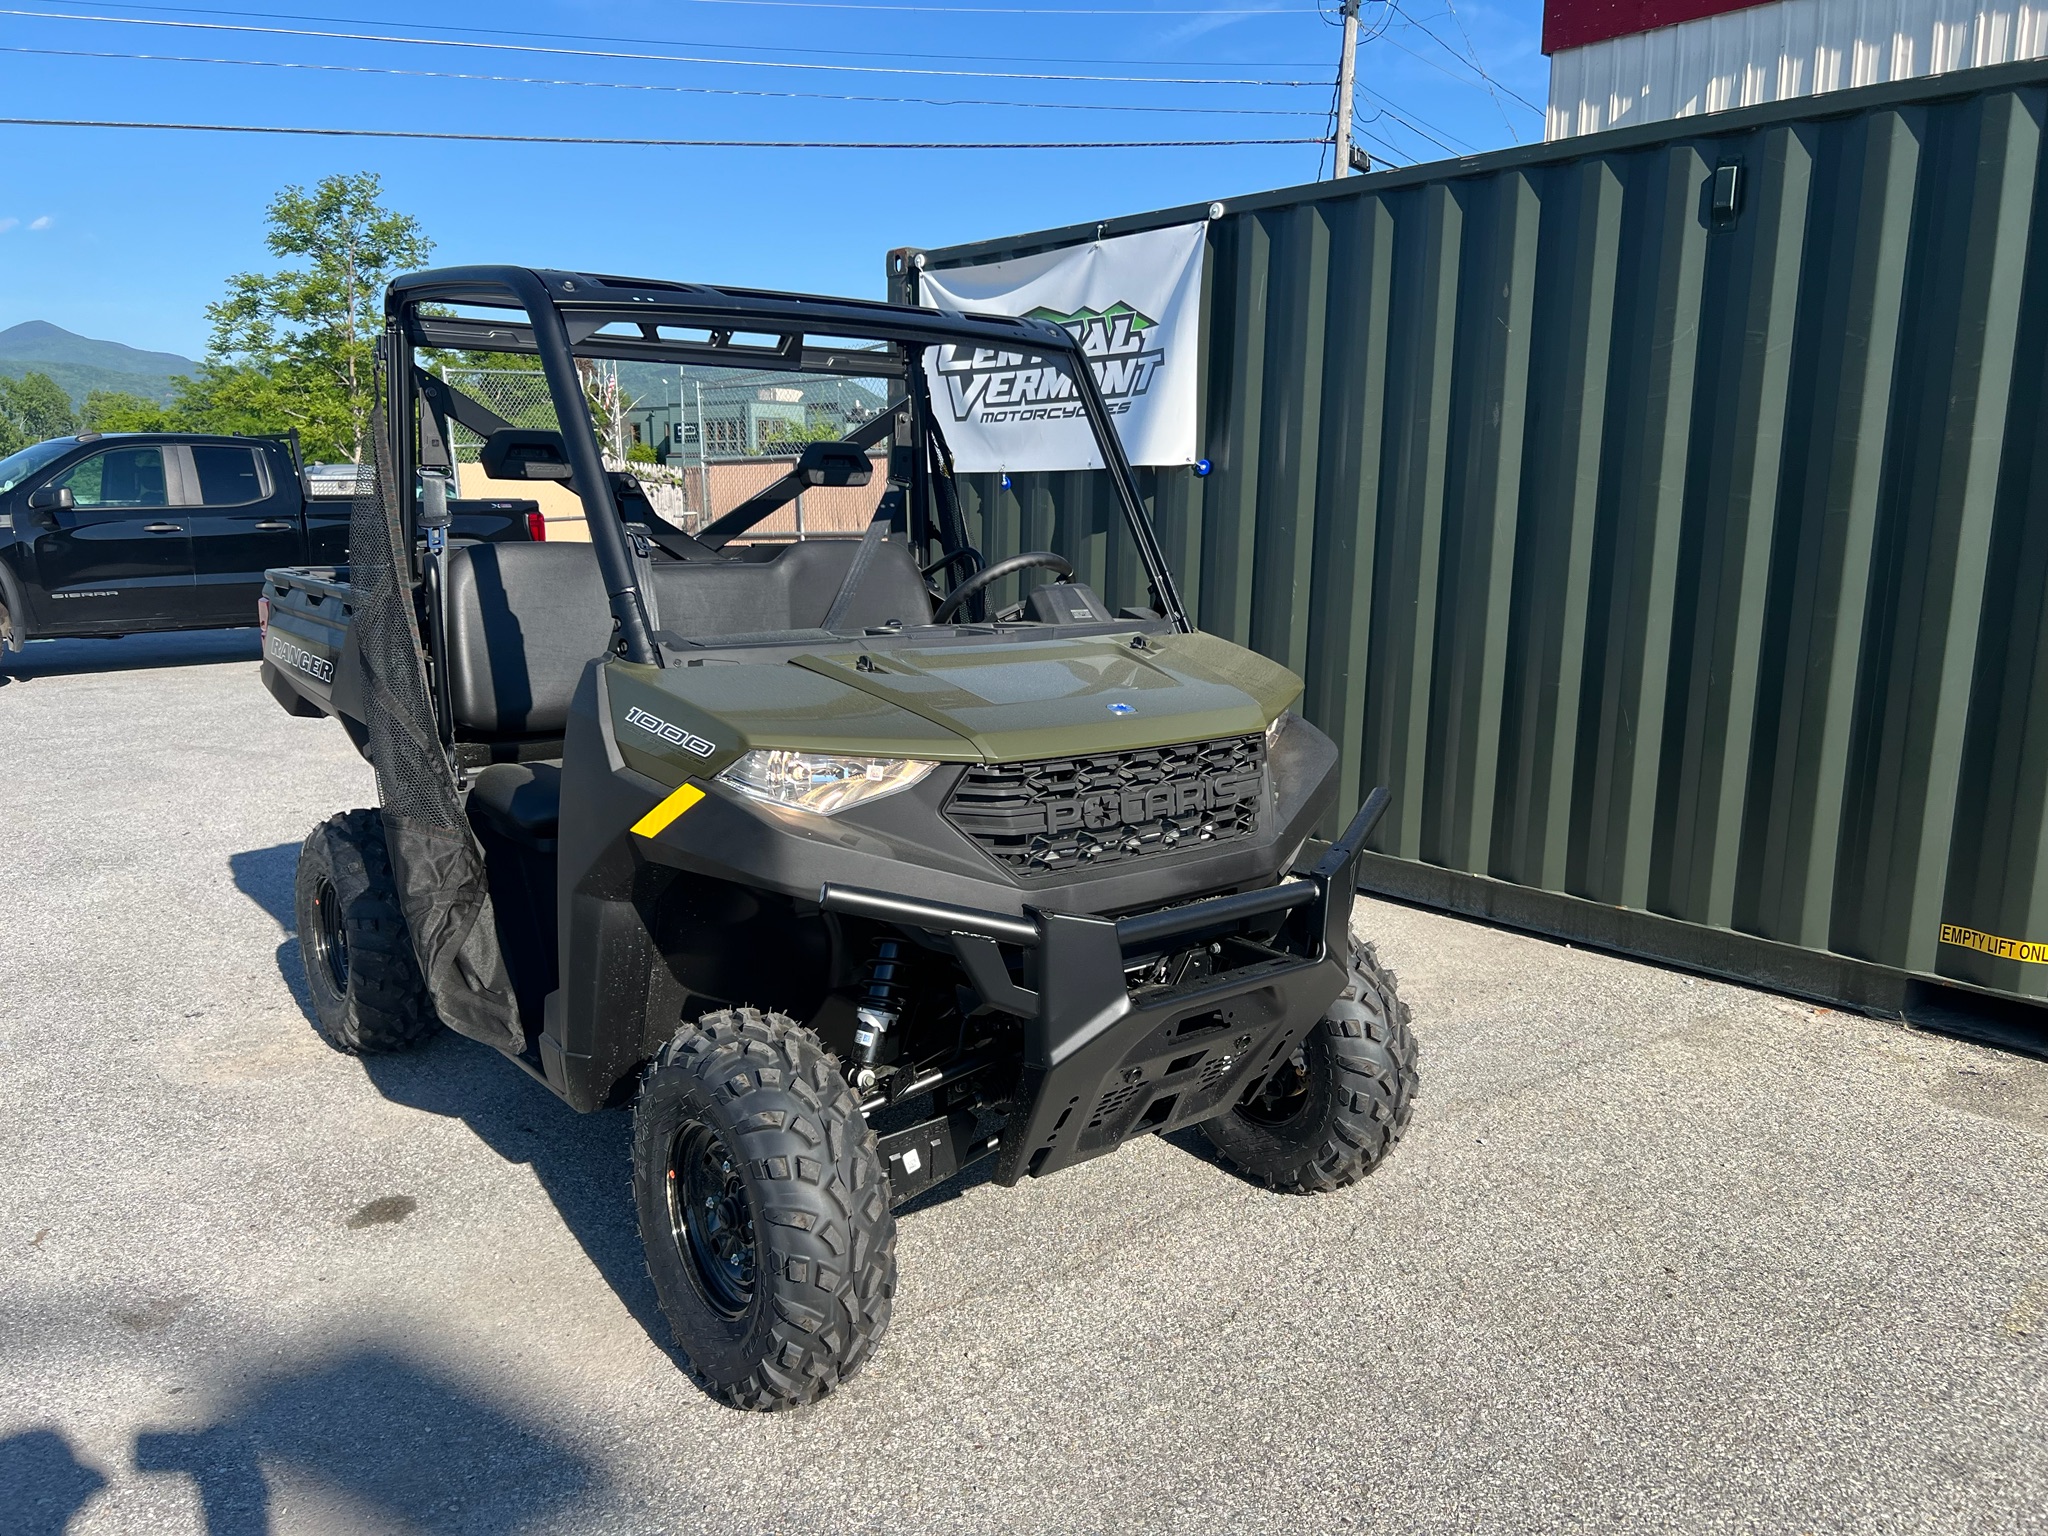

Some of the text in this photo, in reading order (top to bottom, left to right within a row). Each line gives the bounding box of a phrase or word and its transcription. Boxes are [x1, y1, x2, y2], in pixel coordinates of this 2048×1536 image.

[945, 348, 1164, 422] VERMNT
[980, 401, 1132, 423] MOTORCYCES
[51, 590, 119, 599] SIERRA
[271, 636, 334, 683] RANGER
[624, 706, 716, 758] 1000
[1045, 774, 1241, 835] POLARIS
[1942, 926, 1986, 950] EMPTY
[1987, 937, 2016, 957] LIFT
